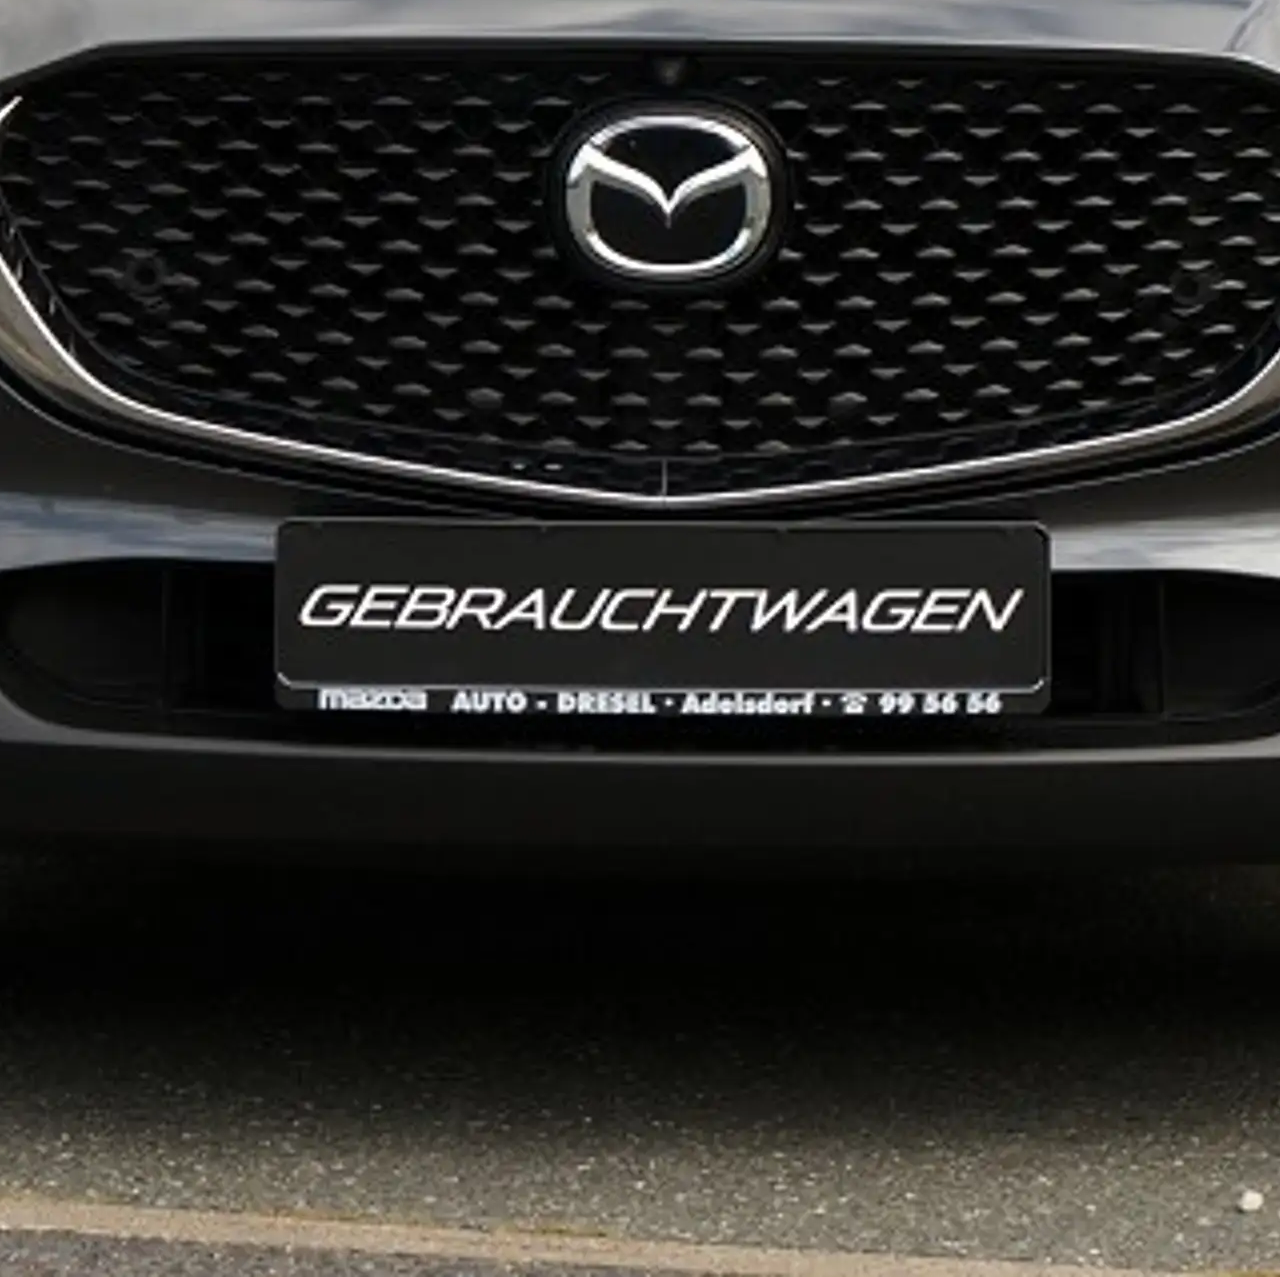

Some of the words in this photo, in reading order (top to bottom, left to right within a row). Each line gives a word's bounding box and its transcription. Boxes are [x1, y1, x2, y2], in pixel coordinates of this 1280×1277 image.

[299, 583, 1024, 632] GEBRAUCHTWAGEN
[451, 691, 528, 713] AUTO
[556, 691, 657, 714] DRESEL
[681, 691, 816, 714] Adelsdorf
[878, 692, 916, 714] 99
